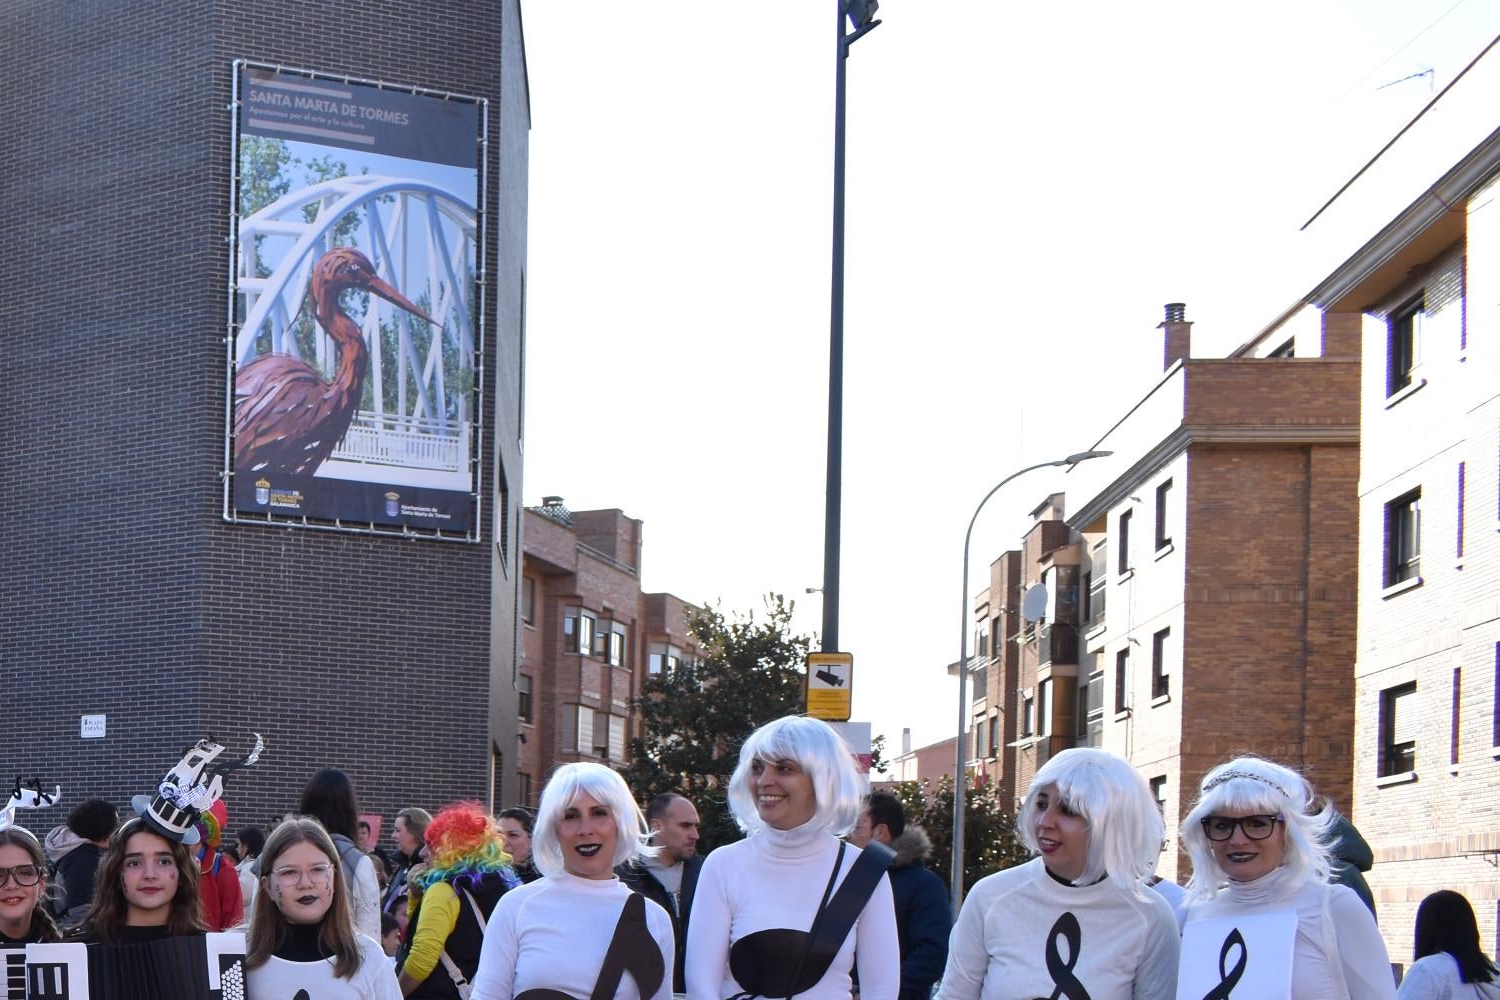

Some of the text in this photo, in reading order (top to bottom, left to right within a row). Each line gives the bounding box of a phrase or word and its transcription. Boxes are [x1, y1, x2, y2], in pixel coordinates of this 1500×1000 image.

[250, 90, 409, 125] SANTA MARTA DE TORMES
[290, 112, 301, 121] por
[311, 116, 326, 124] arte
